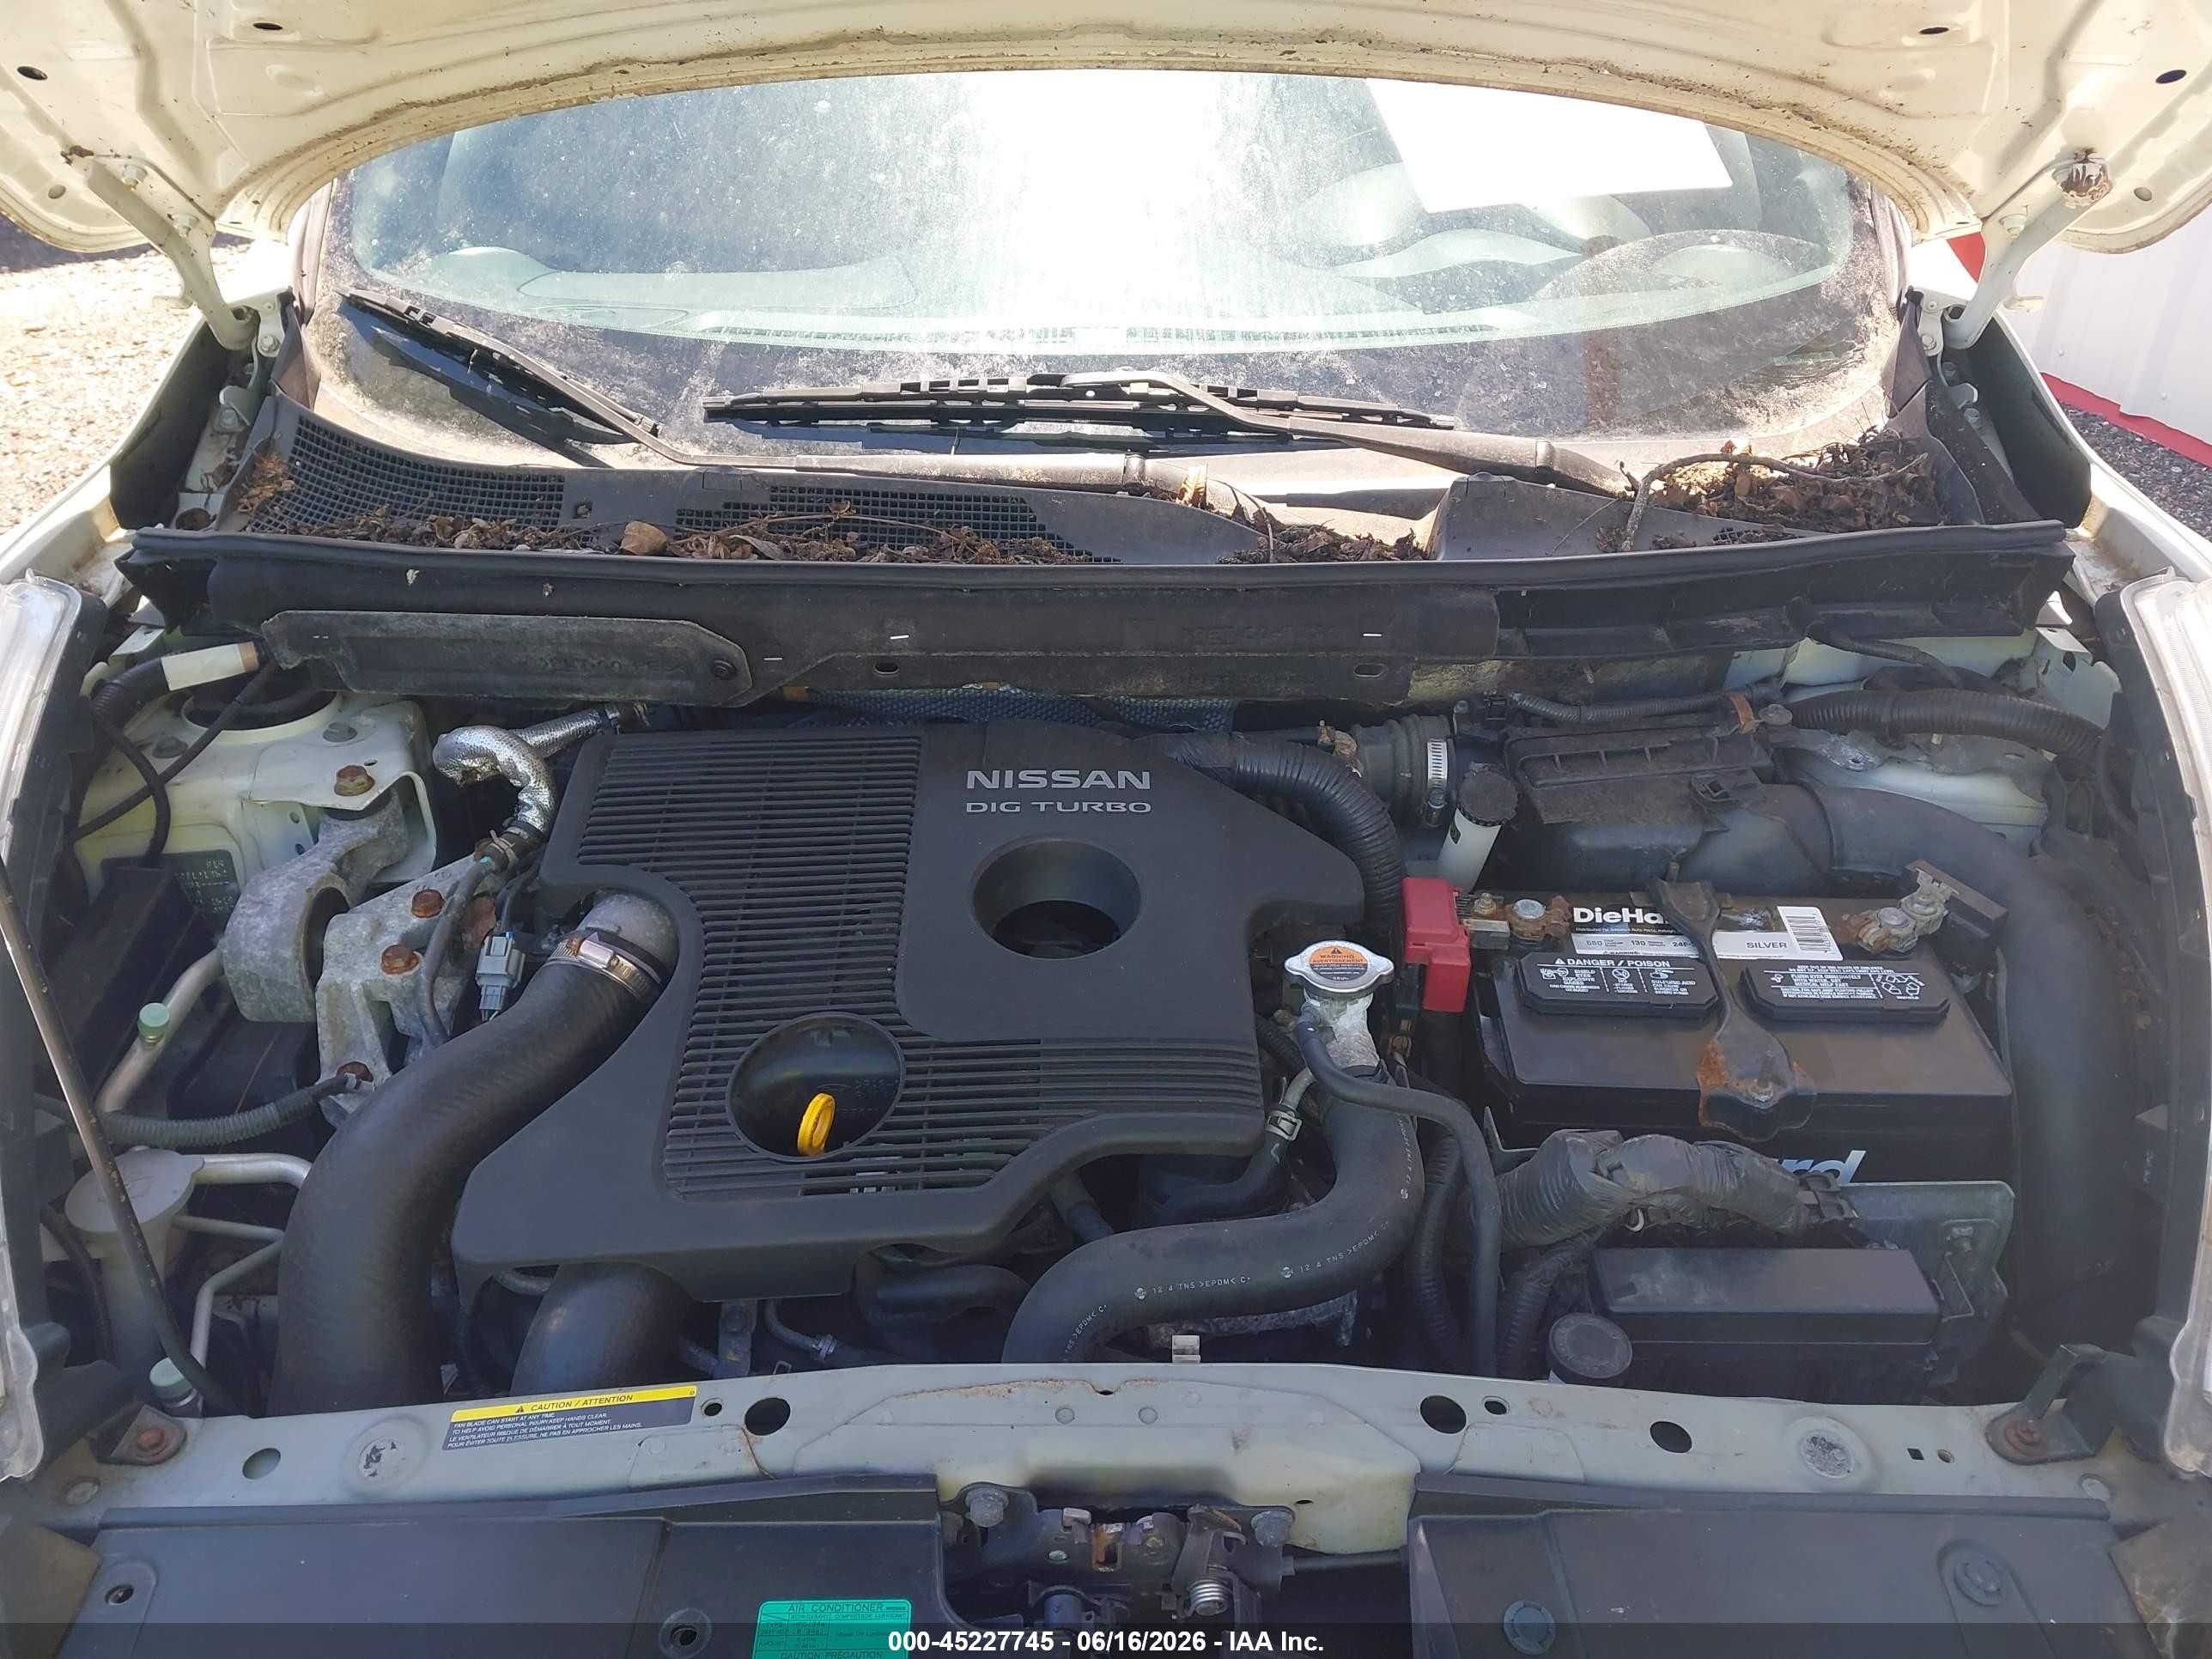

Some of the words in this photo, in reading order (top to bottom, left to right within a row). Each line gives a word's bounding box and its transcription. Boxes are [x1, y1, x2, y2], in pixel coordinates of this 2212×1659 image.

[966, 770, 1151, 790] NISSAN
[966, 802, 1021, 813] DIG
[1031, 802, 1152, 813] TURBO
[1573, 907, 1670, 924] DieHa
[1178, 1281, 1196, 1290] TNS
[530, 1401, 573, 1412] CAUTION
[581, 1394, 634, 1407] ATTENTION
[571, 1425, 610, 1435] APPROCHER
[458, 1431, 496, 1441] VENTILATEUR
[787, 1604, 805, 1613] AIR
[811, 1603, 884, 1613] CONDITIONER
